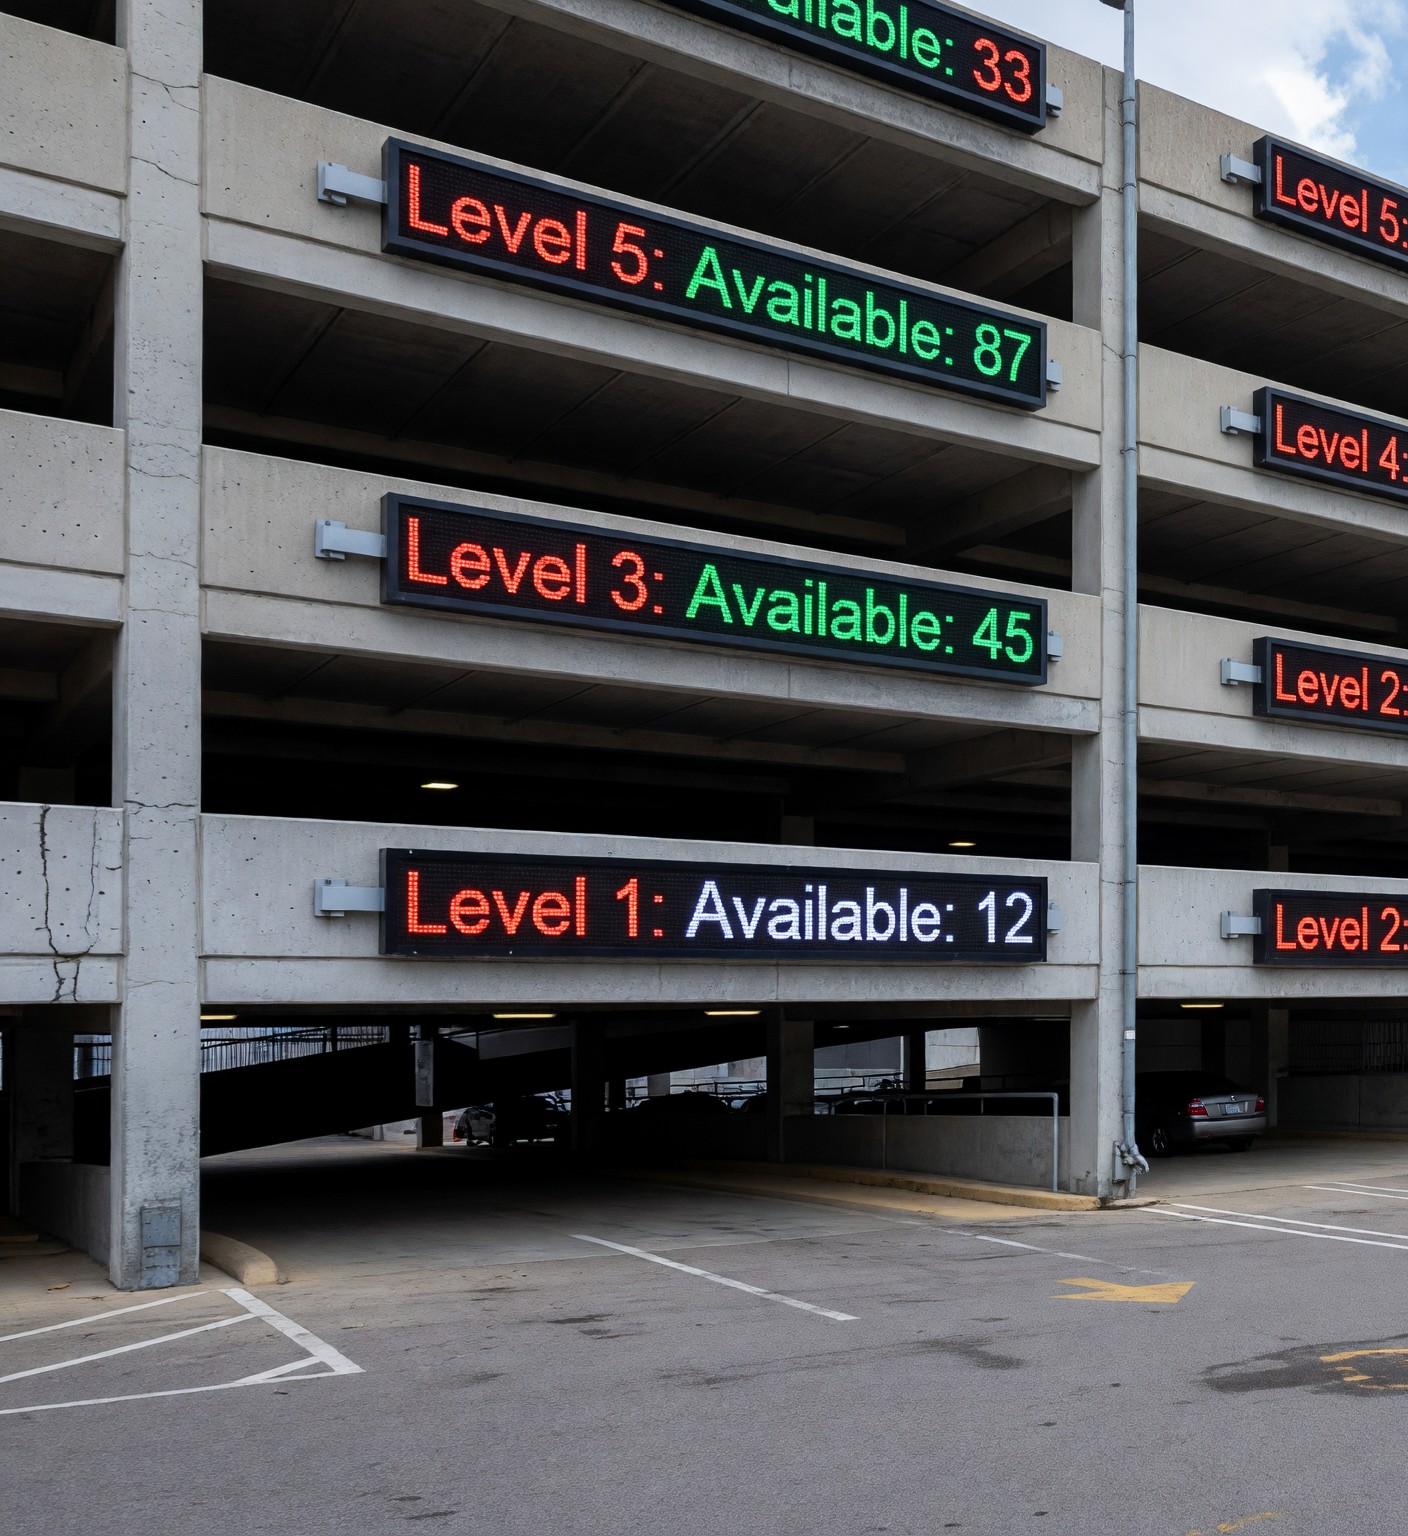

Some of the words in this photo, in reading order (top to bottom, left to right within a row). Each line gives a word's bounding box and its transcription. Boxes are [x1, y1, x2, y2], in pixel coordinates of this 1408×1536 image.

[974, 38, 1031, 103] 33
[1276, 155, 1368, 232] Level
[1380, 198, 1408, 248] 5:
[408, 164, 587, 270] Level
[611, 223, 663, 290] 5:
[686, 246, 953, 365] Available:
[974, 323, 1032, 382] 87
[1276, 404, 1368, 472] Level
[1379, 437, 1408, 482] 4:
[408, 518, 587, 603] Level
[611, 551, 663, 614] 3:
[686, 564, 953, 653] Available:
[973, 608, 1033, 663] 45
[1276, 653, 1368, 711] Level
[1380, 670, 1408, 716] 2:
[408, 870, 587, 936] Level
[615, 878, 663, 937] 1:
[686, 881, 953, 942] Available:
[979, 891, 1033, 943] 12
[1276, 904, 1368, 950] Level
[1380, 907, 1408, 951] 2:
